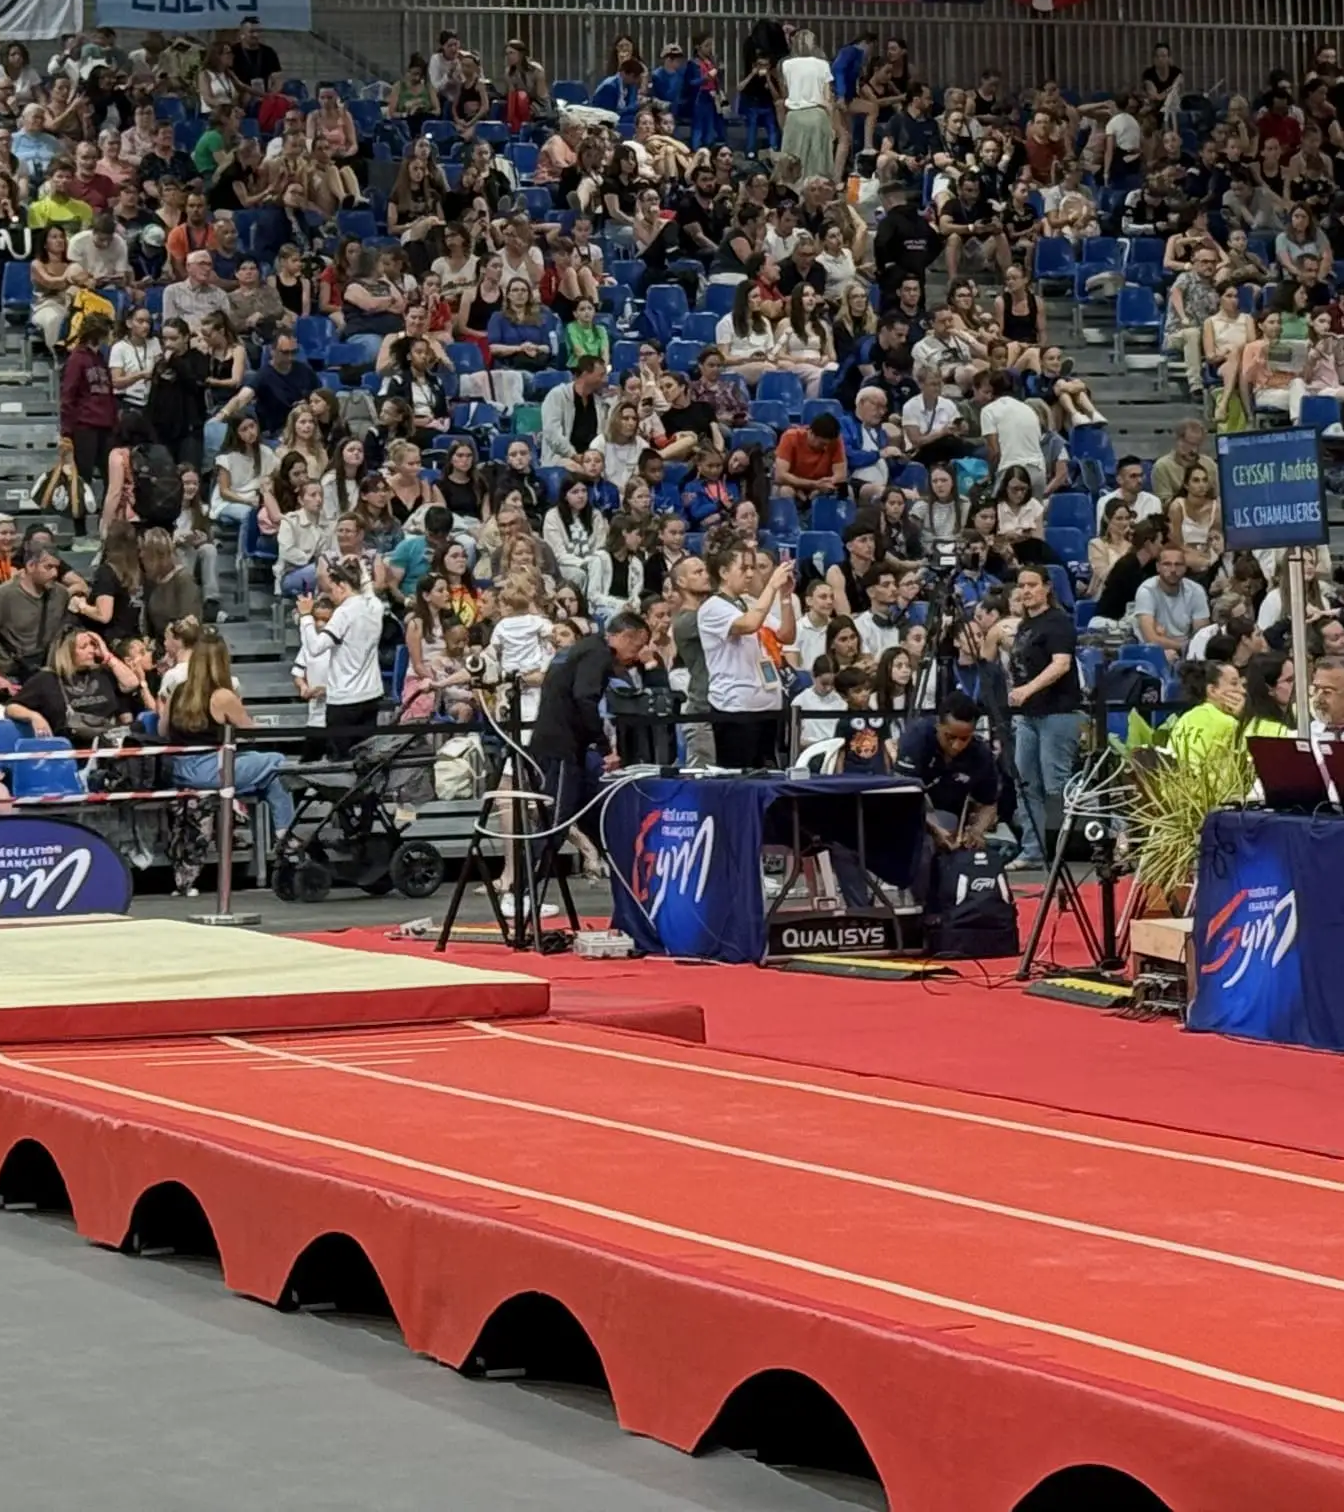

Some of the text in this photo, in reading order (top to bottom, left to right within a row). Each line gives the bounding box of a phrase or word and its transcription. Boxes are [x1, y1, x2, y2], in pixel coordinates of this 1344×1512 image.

[1233, 457, 1320, 486] CEYSSAT Andréa
[782, 926, 886, 949] QUALISYS
